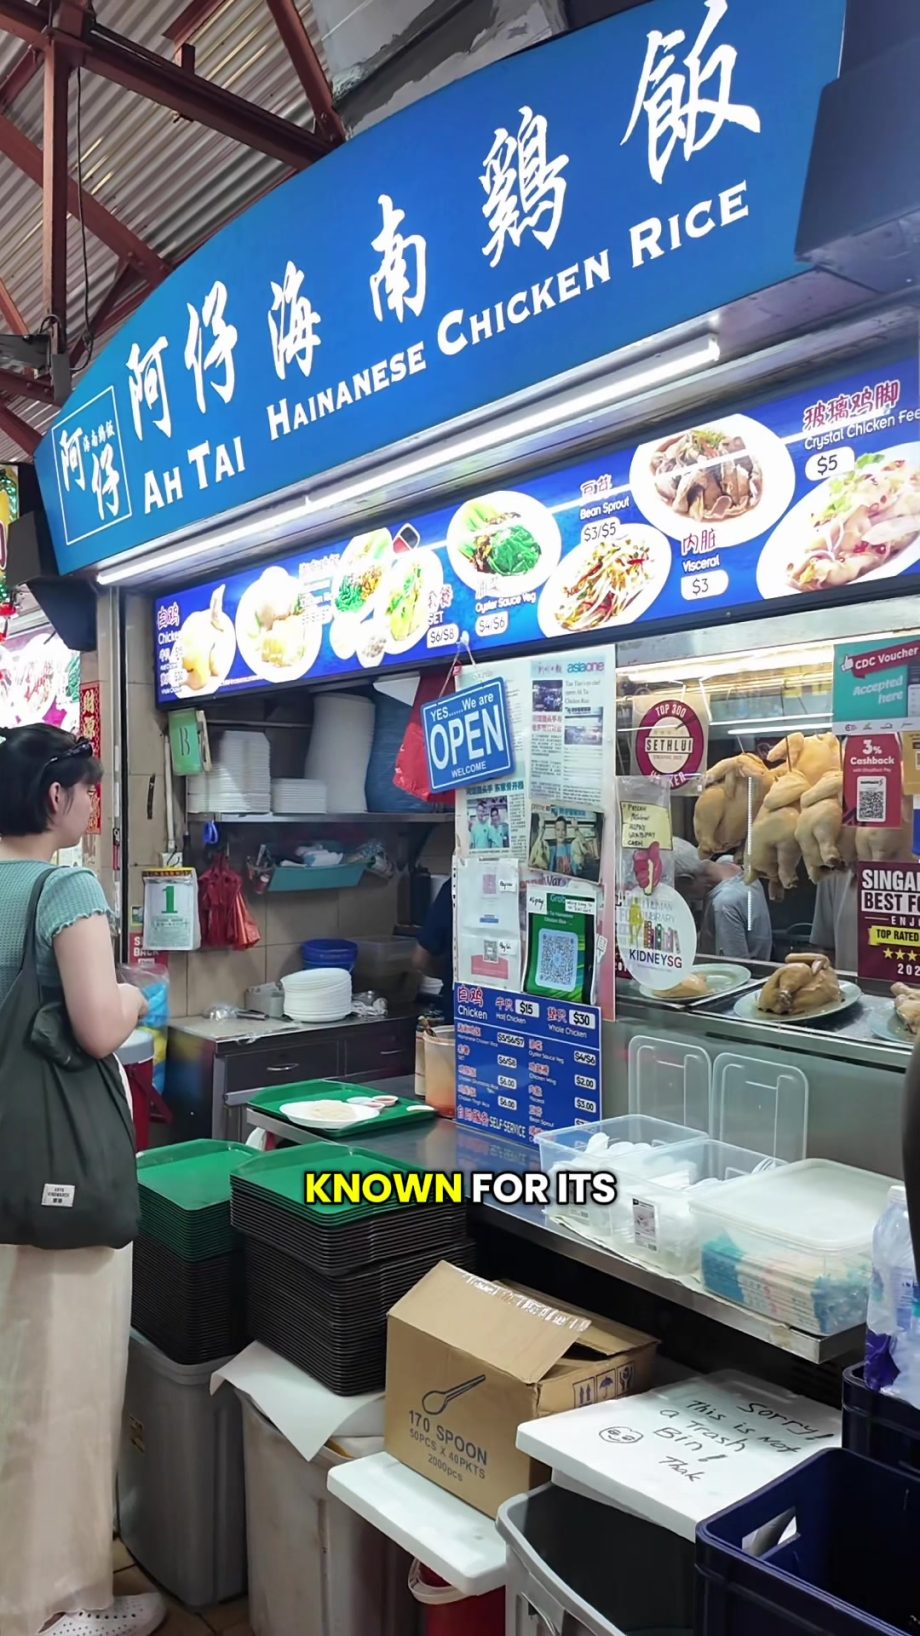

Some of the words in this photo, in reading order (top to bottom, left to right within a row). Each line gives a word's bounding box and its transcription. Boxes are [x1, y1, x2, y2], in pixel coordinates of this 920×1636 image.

[187, 441, 246, 490] TAI
[266, 341, 427, 441] HAINANESE
[437, 249, 611, 356] CHICKEN
[629, 180, 749, 269] RICE
[804, 380, 900, 431] 玻璃鸡脚
[804, 430, 844, 450] Crystal
[846, 416, 896, 438] Chicken
[817, 454, 838, 475] $5
[580, 506, 601, 520] Bean
[602, 496, 631, 515] Sprout
[584, 522, 616, 541] $3/$5
[681, 529, 717, 557] 内脏
[683, 554, 720, 572] Visceral
[692, 577, 709, 595] $3
[428, 611, 444, 625] SET
[567, 661, 604, 673] asiaone
[855, 657, 876, 670] CDC
[877, 646, 919, 665] Voucher
[853, 675, 903, 696] Accepted
[478, 692, 494, 706] are
[878, 690, 903, 704] here
[655, 703, 670, 717] TOP
[671, 703, 687, 718] 300
[430, 705, 504, 770] OPEN
[646, 738, 692, 752] SETHLUI
[451, 761, 487, 778] WELCOME
[850, 756, 895, 765] Cashback
[862, 869, 920, 892] SINGA
[161, 886, 178, 914] 1
[864, 891, 903, 912] BEST
[907, 894, 920, 913] F
[876, 928, 892, 939] TOP
[893, 930, 920, 942] RATED
[629, 948, 682, 969] KIDNEYSG
[457, 985, 484, 1008] 白鸡
[457, 1004, 488, 1021] Chicken
[519, 1002, 534, 1015] $15
[506, 1015, 527, 1025] Chicken
[573, 1012, 590, 1027] $30
[547, 1023, 565, 1035] Whole
[565, 1027, 588, 1039] Chicken
[574, 1051, 596, 1065] $4/$6
[575, 1076, 595, 1089] $2.00
[575, 1098, 595, 1112] $3.00
[489, 1115, 526, 1139] SELF-SERVICE
[659, 1408, 680, 1419] a
[684, 1400, 727, 1422] This
[733, 1422, 756, 1435] is
[737, 1402, 835, 1441] Sorry!
[409, 1410, 430, 1433] 170
[436, 1424, 487, 1466] SPOON
[428, 1452, 463, 1482] 2000pcs
